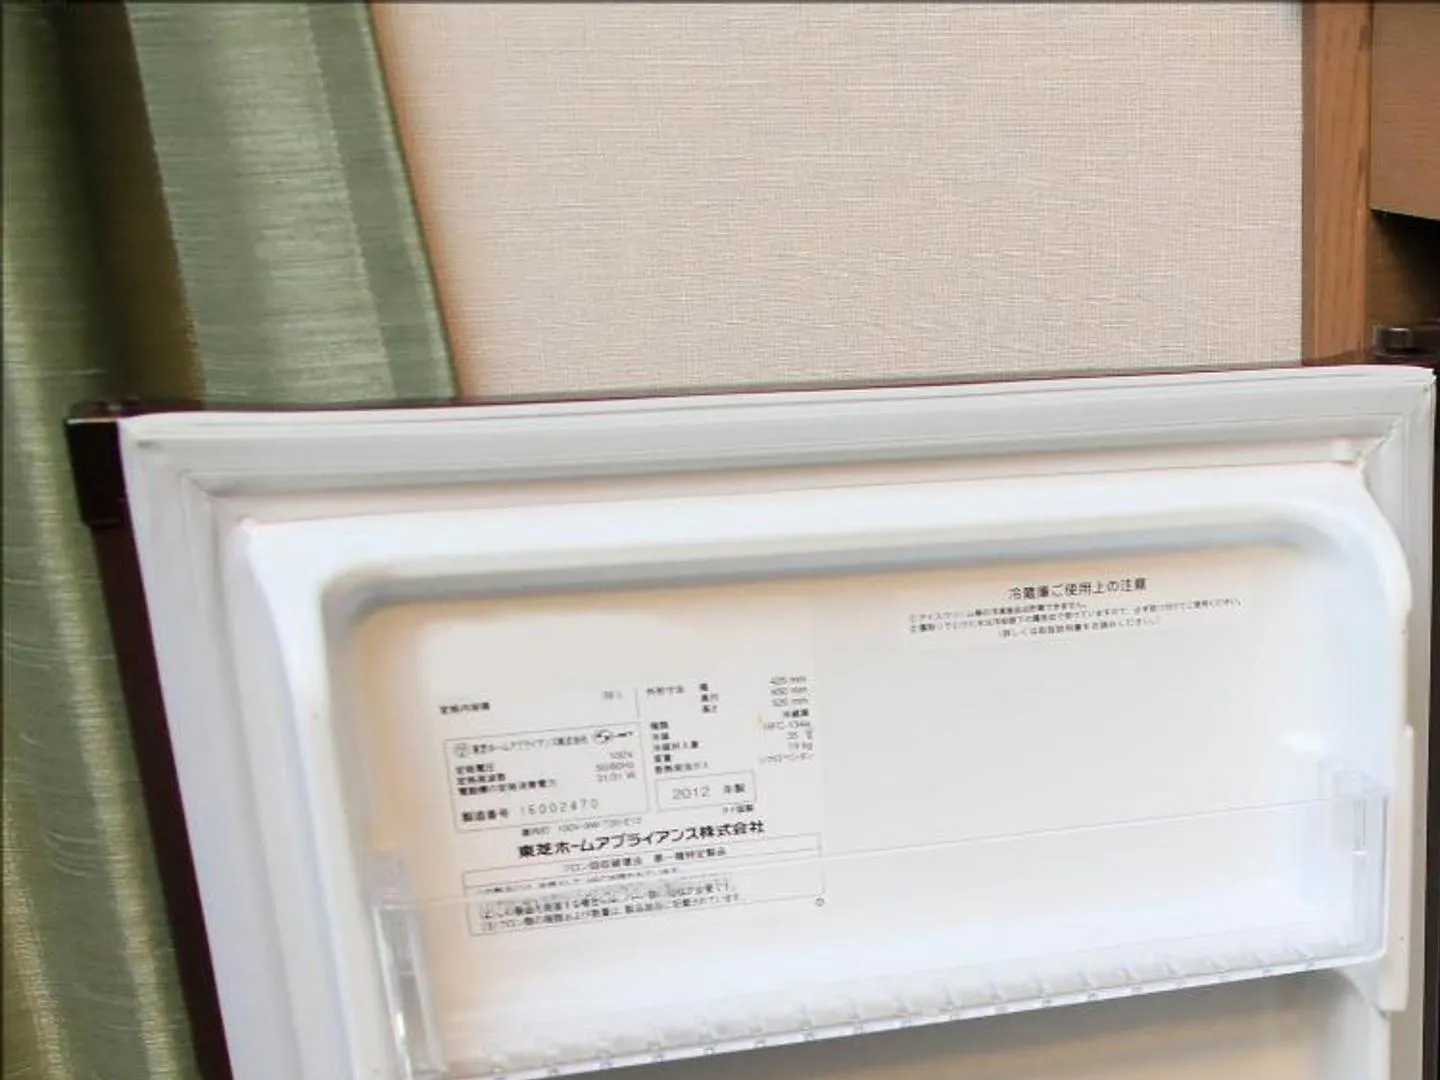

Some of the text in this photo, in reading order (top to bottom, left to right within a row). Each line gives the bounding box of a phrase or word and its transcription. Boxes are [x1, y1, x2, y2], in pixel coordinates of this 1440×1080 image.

[1008, 578, 1147, 600] 冷蔵庫ご使用上の注意
[672, 786, 711, 801] 2012
[519, 820, 764, 858] 東芝ホームアプライアンス株式会社
